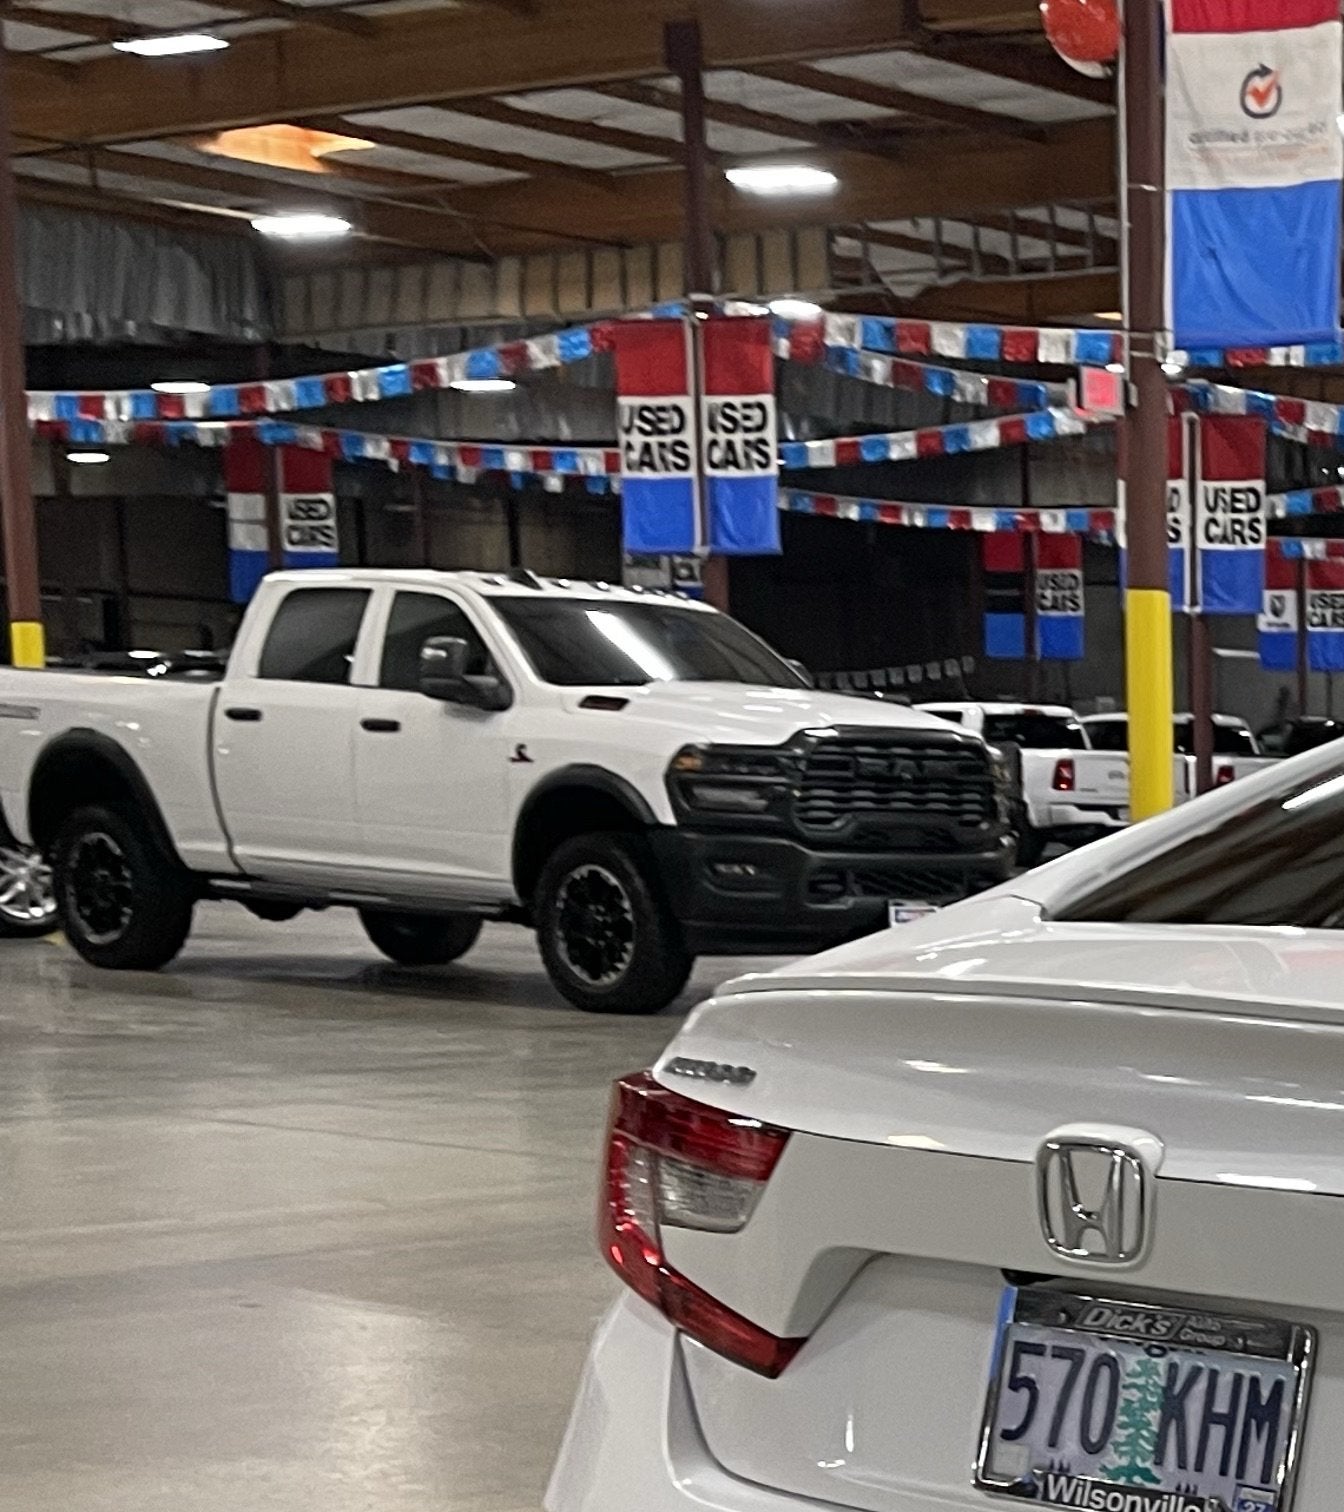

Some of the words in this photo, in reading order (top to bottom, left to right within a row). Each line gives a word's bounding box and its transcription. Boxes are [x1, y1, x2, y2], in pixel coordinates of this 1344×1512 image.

[1204, 486, 1261, 513] USED
[1204, 517, 1262, 545] CARS
[1084, 1307, 1172, 1337] Dick's
[1000, 1340, 1121, 1455] 570
[1153, 1362, 1286, 1485] KHM
